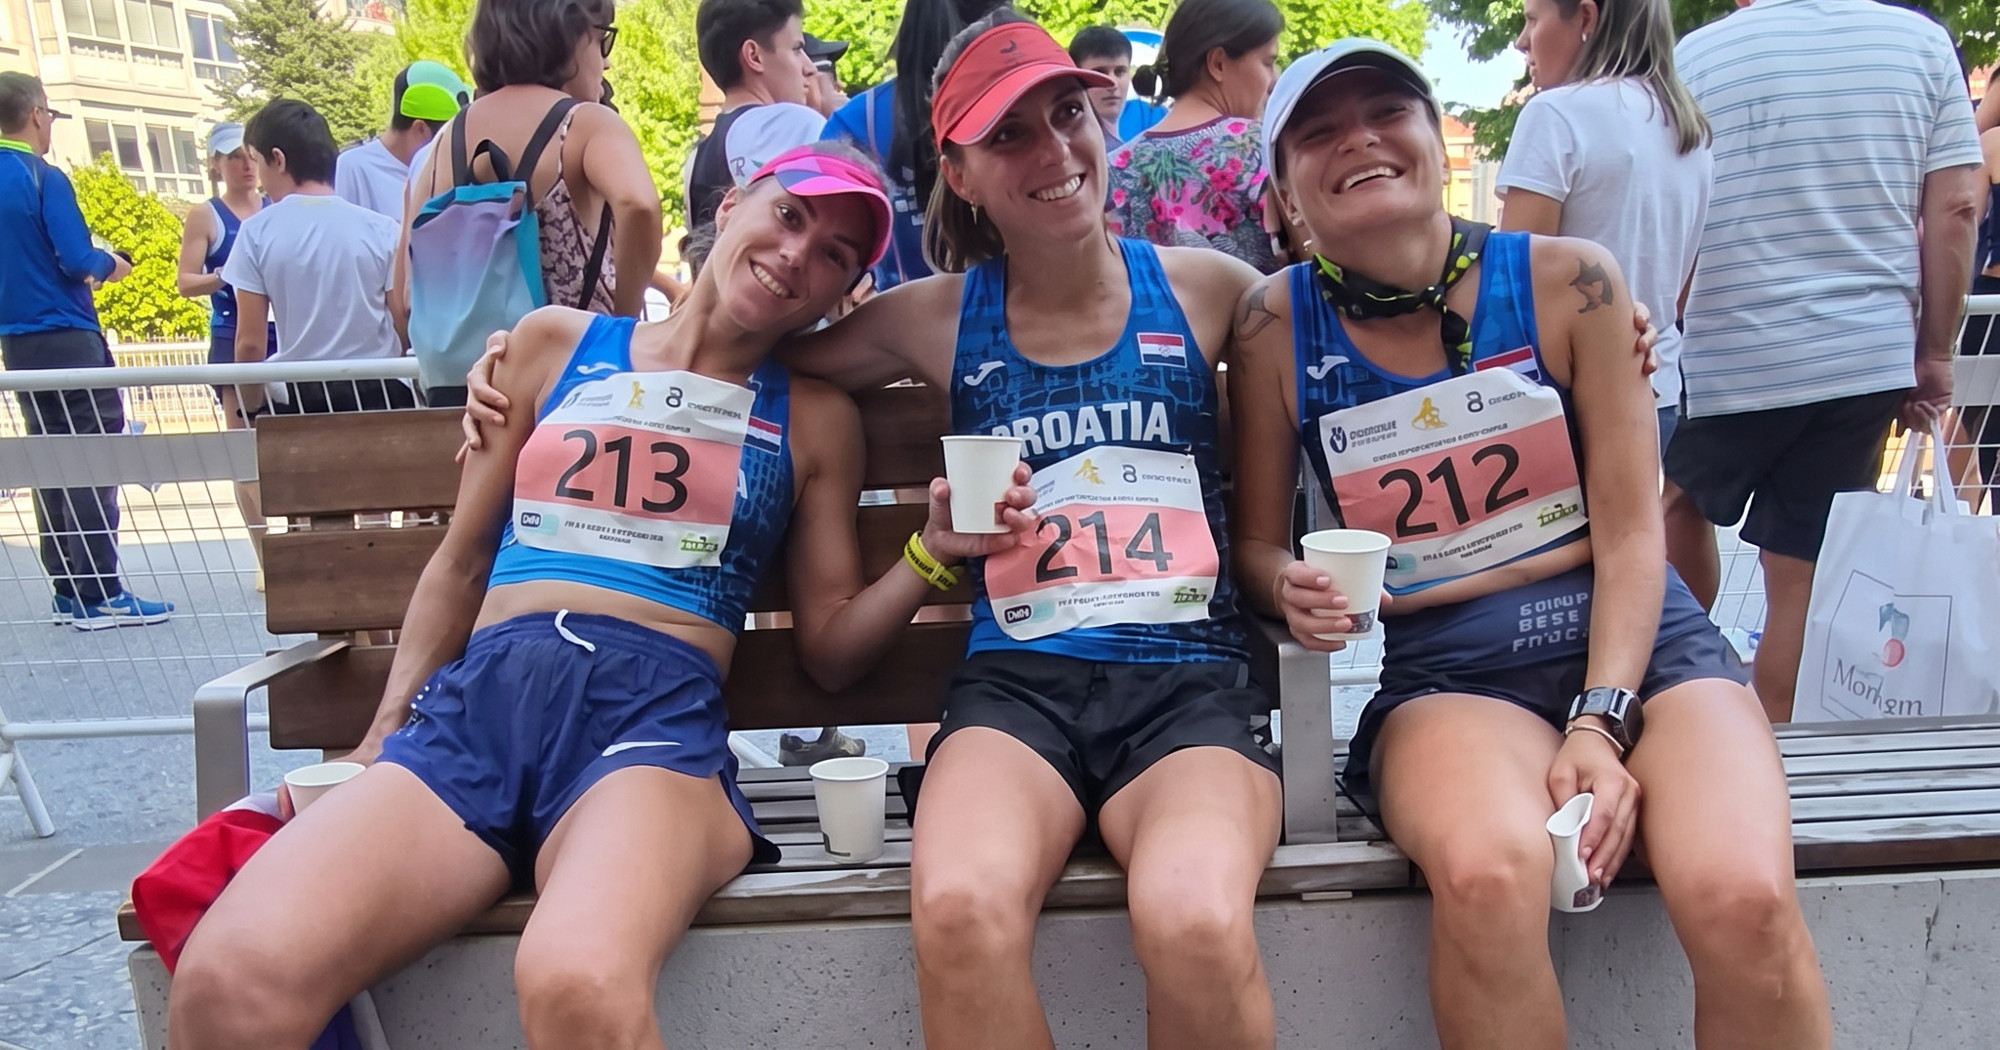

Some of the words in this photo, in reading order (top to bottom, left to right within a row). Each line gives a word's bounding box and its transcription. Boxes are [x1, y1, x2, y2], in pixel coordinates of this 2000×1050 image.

[554, 428, 691, 514] 213
[1378, 443, 1529, 539] 212
[1035, 509, 1174, 584] 214
